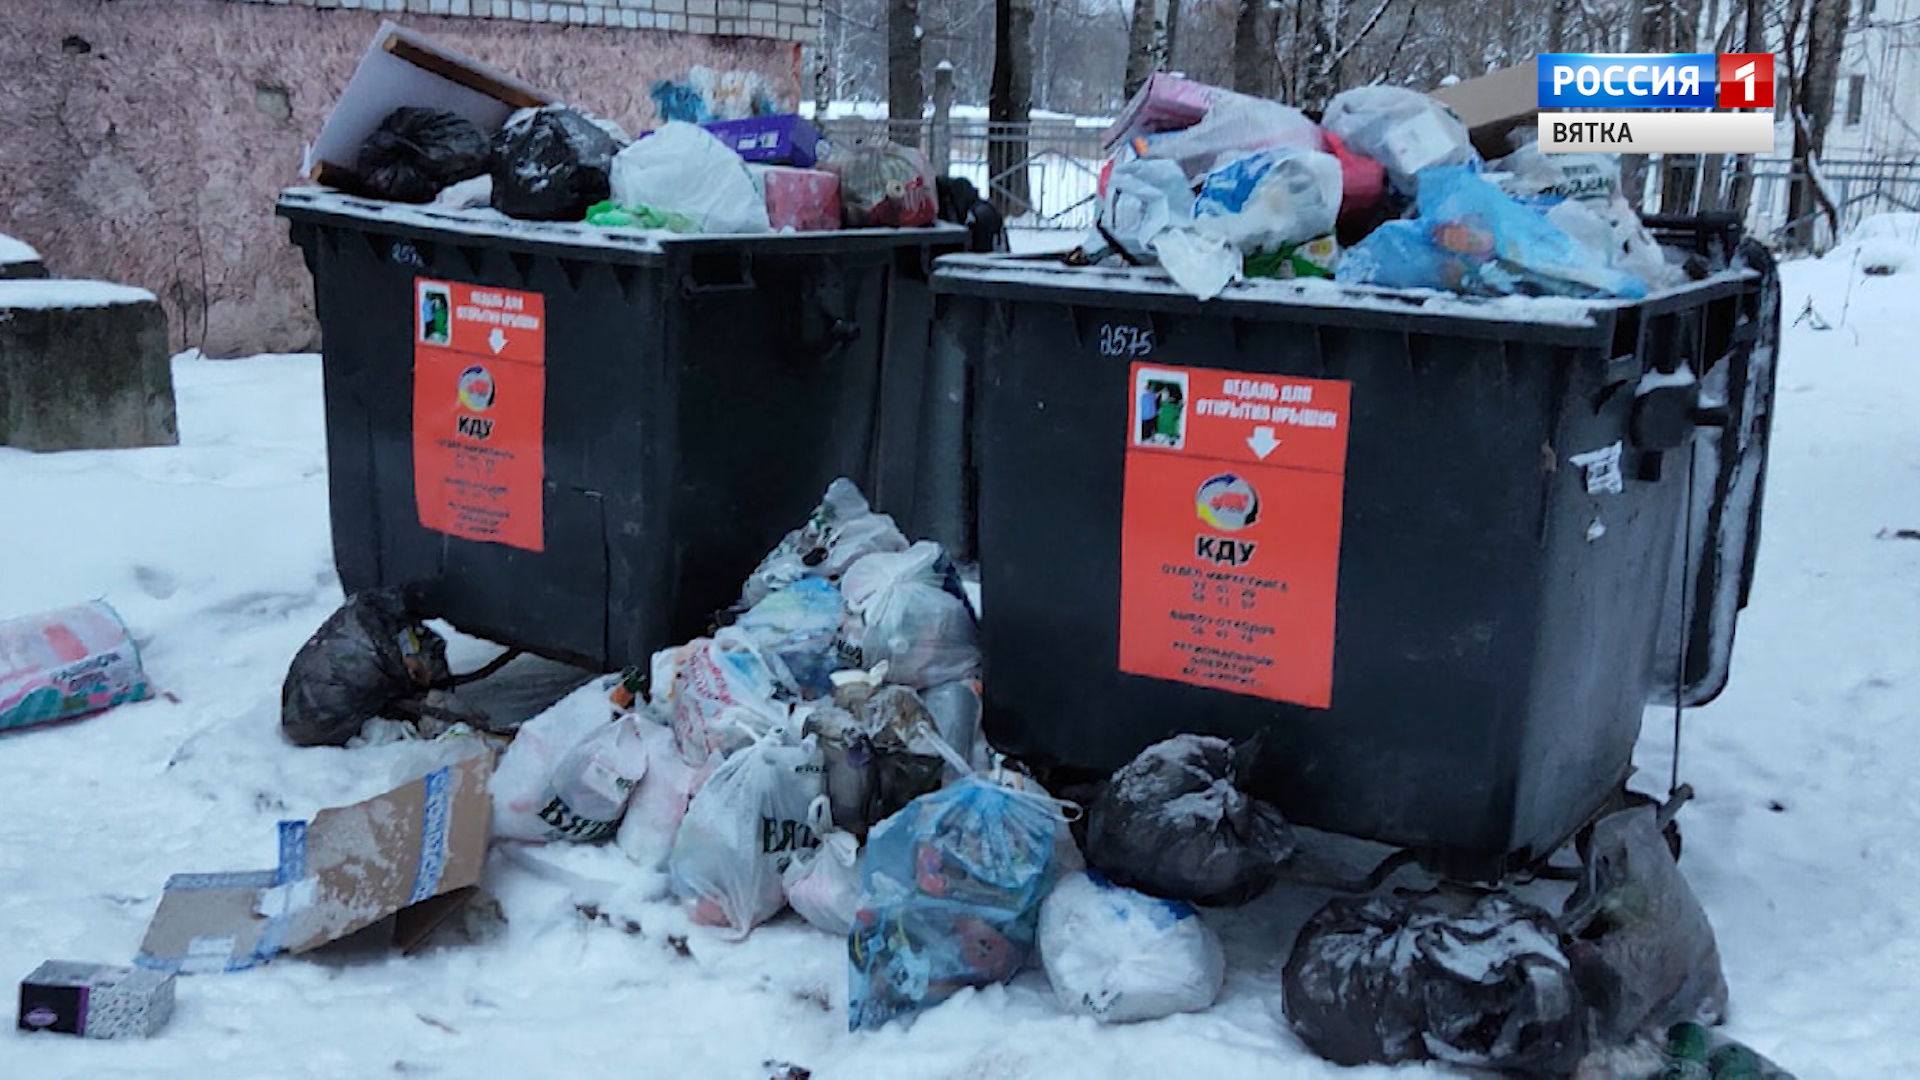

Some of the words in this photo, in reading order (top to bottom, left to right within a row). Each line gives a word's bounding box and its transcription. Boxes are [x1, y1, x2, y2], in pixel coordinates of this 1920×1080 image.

[1100, 323, 1153, 357] 2575
[1222, 378, 1279, 401] ПЕДАЛЬ
[1280, 384, 1314, 404] ДЛЯ
[457, 415, 494, 440] КДУ
[1196, 532, 1258, 567] КДУ
